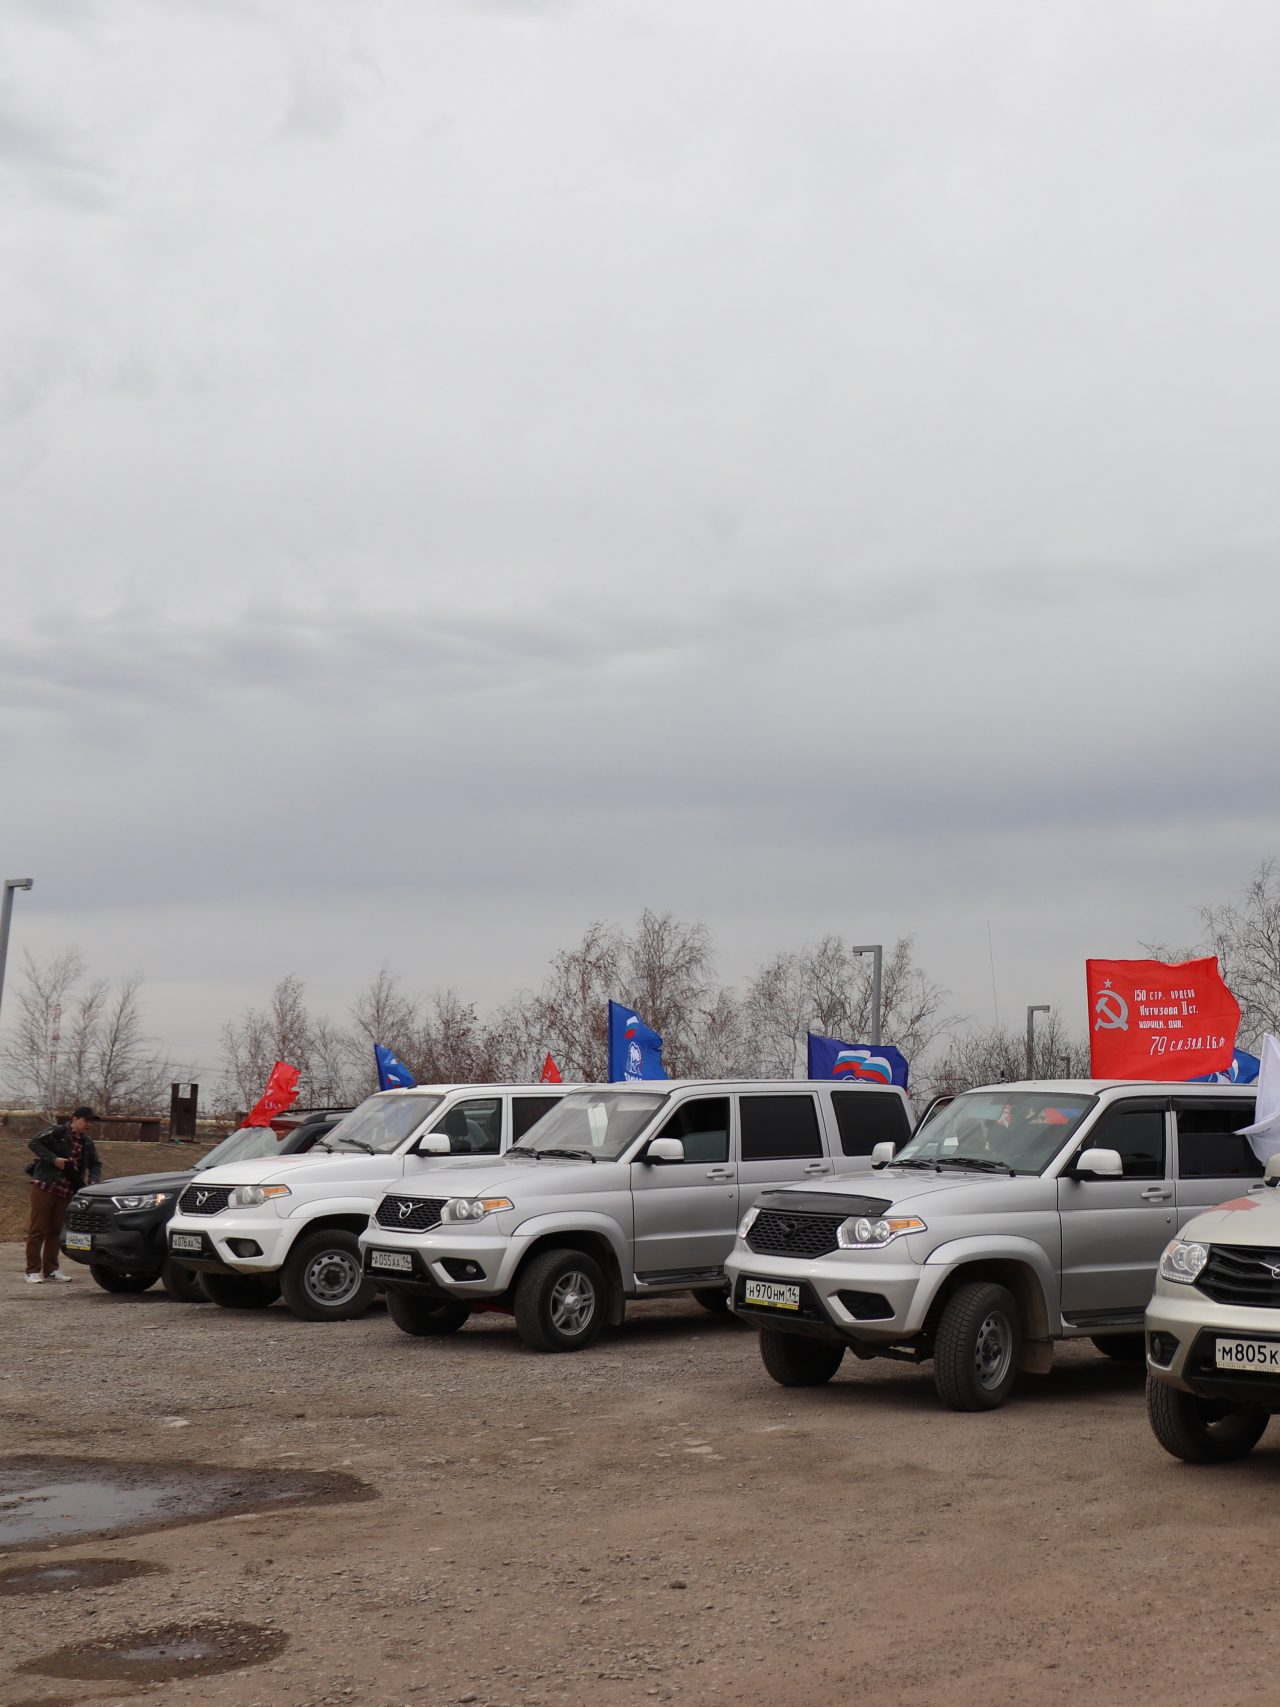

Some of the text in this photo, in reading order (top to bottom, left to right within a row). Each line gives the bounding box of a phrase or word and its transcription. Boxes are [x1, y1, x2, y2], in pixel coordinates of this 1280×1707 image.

[1134, 989, 1146, 1001] 150
[1150, 1036, 1167, 1055] 79
[749, 1284, 797, 1301] Н970НМ 14
